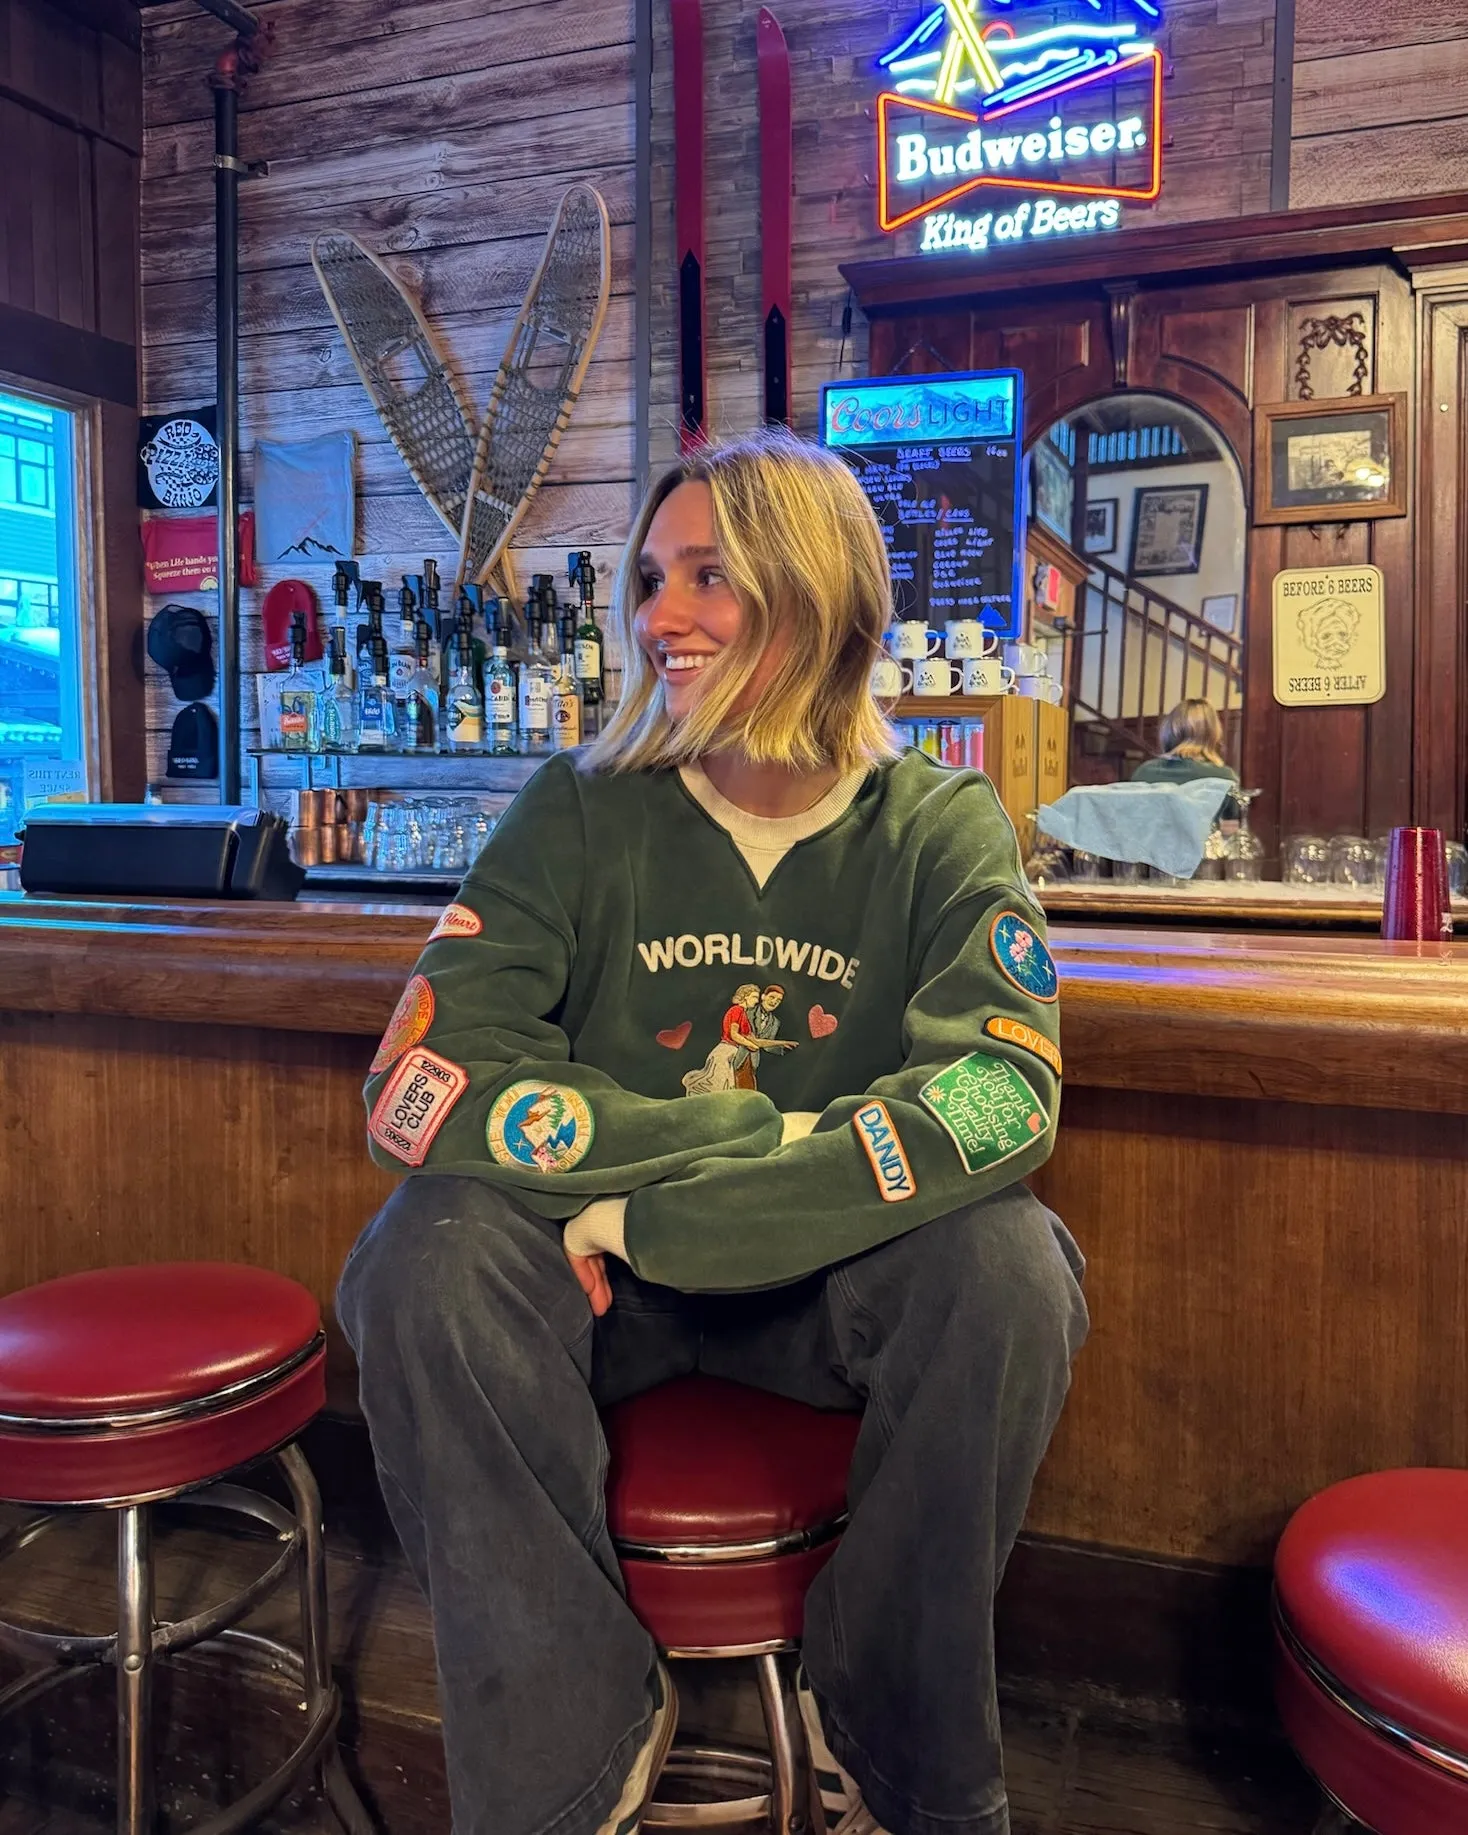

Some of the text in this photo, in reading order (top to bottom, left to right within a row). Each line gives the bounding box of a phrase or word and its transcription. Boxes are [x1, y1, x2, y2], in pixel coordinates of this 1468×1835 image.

[920, 199, 1120, 250] King of Beers
[164, 421, 192, 440] RED
[831, 396, 1009, 433] Coors LIGHT
[163, 488, 202, 506] BANJO
[153, 569, 181, 581] Squeeze
[182, 566, 201, 575] them
[185, 556, 207, 565] hands
[1283, 577, 1373, 597] BEFORE 6 BEERS
[1288, 675, 1368, 693] AFTER 6 BEERS
[442, 911, 478, 930] Heart
[637, 933, 860, 990] WORLDWIDE
[391, 1072, 429, 1130] LOVERS
[956, 1065, 1017, 1150] Choosing
[977, 1067, 1021, 1130] You for
[992, 1062, 1029, 1118] Thank
[407, 1091, 435, 1130] CLUB
[947, 1102, 985, 1154] Time!
[949, 1088, 994, 1143] Quality
[489, 1131, 511, 1163] SEE
[858, 1107, 910, 1194] DANDY
